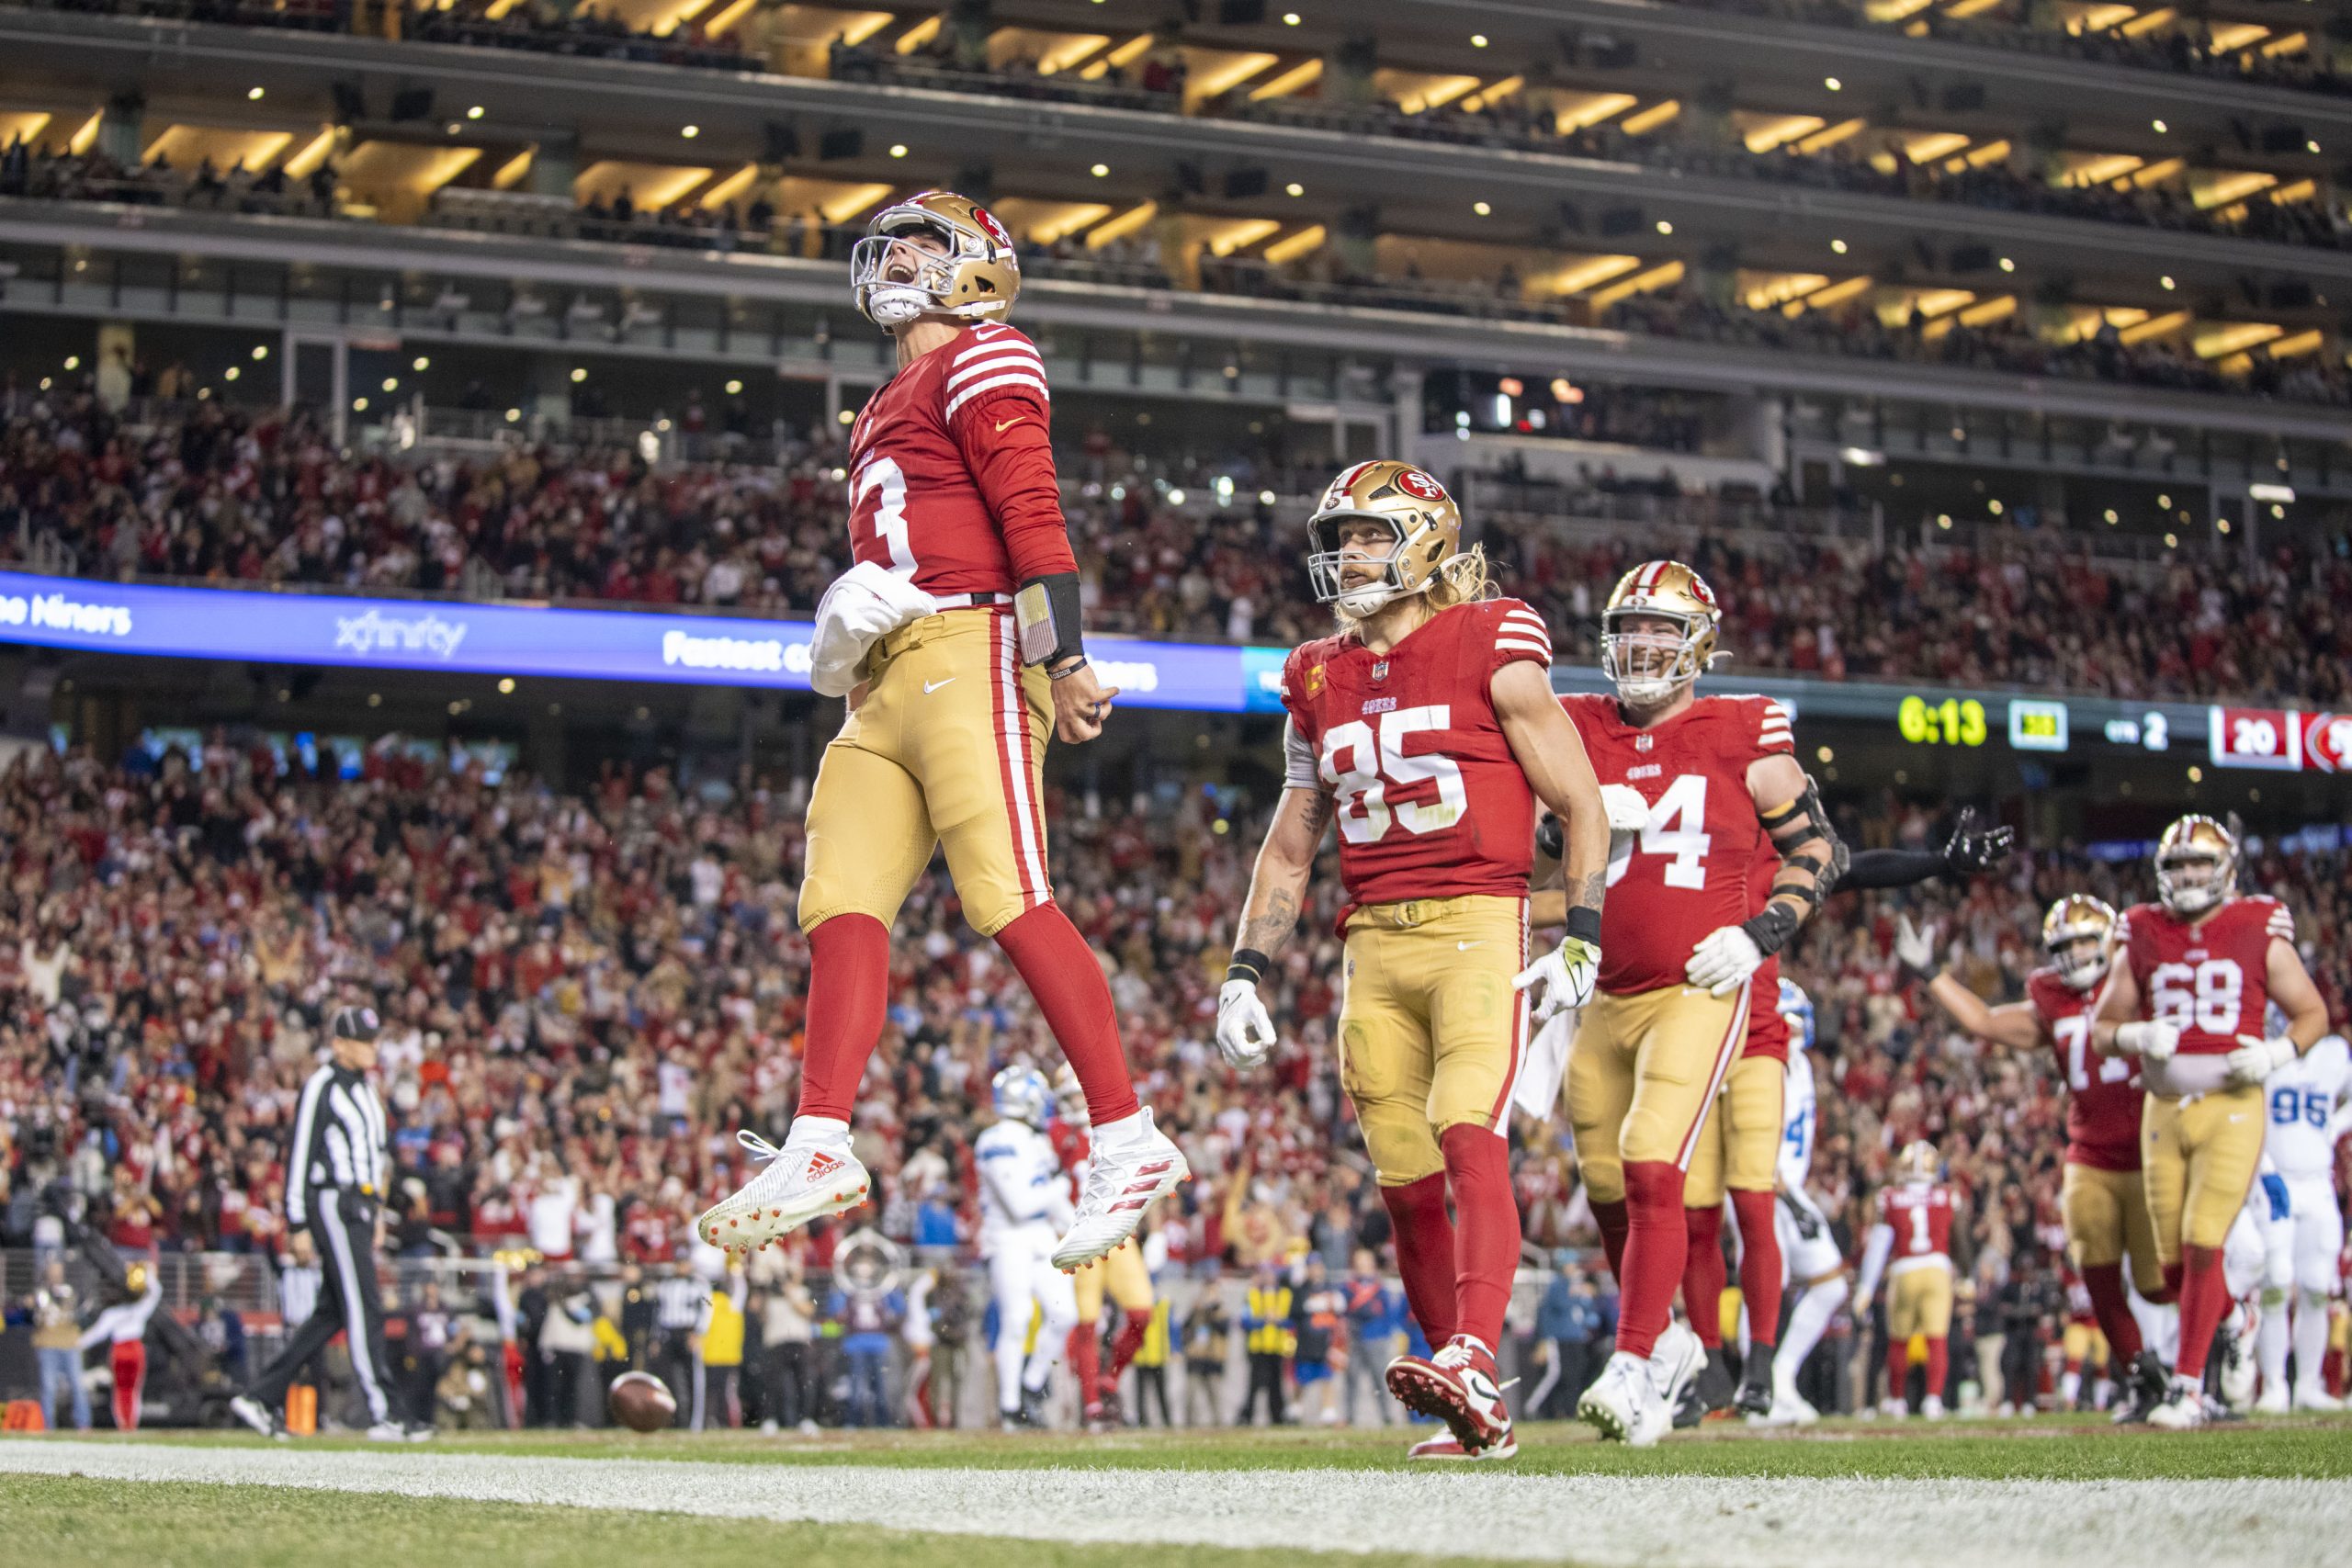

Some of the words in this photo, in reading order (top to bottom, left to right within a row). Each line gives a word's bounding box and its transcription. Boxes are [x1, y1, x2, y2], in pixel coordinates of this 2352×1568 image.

[1407, 473, 1441, 498] SF
[849, 456, 919, 583] 3
[31, 593, 132, 636] Niners
[336, 609, 468, 656] xfinity
[1362, 696, 1397, 715] 49ERS
[1898, 695, 1986, 746] 6:13
[2143, 711, 2169, 751] 2
[2233, 717, 2277, 757] 20
[1320, 705, 1467, 844] 85
[2151, 958, 2243, 1035] 68
[807, 1160, 846, 1183] adidas
[1909, 1204, 1932, 1252] 1
